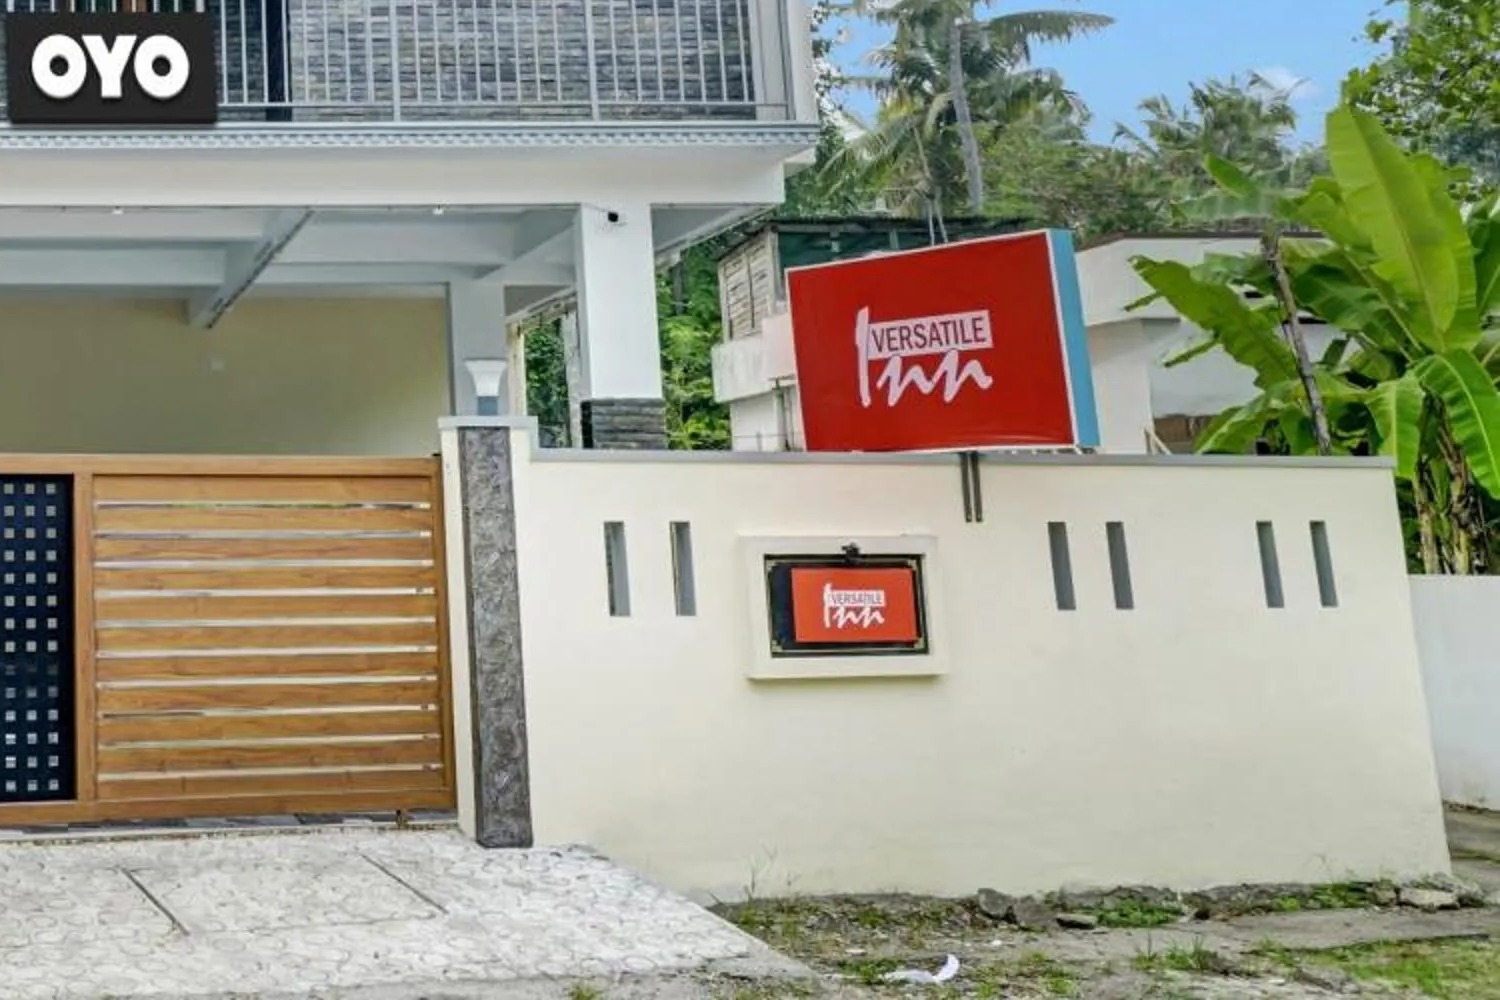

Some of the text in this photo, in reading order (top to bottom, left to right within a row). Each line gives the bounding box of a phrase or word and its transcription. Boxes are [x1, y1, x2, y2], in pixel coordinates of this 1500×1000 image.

[31, 34, 190, 99] OYO
[871, 315, 987, 353] VERSATILE
[831, 591, 883, 605] VERSATILE
